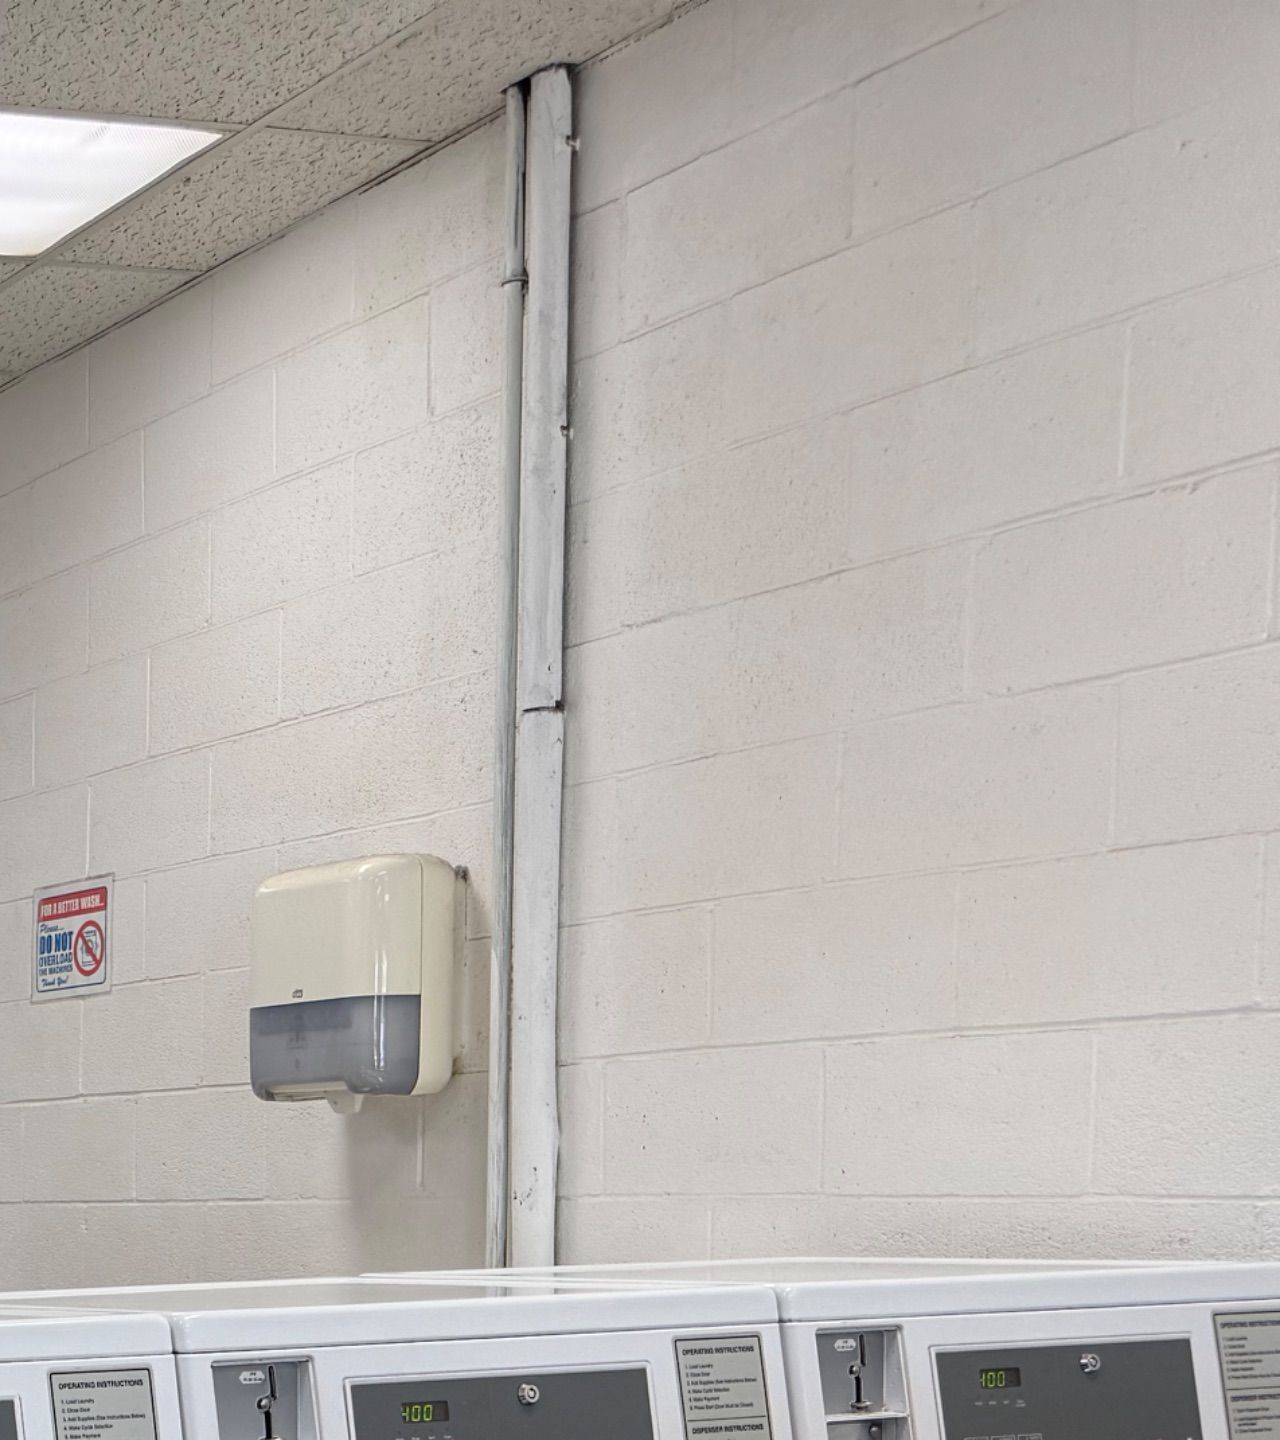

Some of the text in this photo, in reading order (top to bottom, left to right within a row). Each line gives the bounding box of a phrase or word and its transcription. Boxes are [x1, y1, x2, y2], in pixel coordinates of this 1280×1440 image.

[39, 931, 73, 954] DO NOT
[39, 952, 73, 967] OVERLOAD
[682, 1346, 754, 1356] OPERATING INSTRUCTIONS
[58, 1379, 143, 1390] OPERATING INSTRUCTIONS
[692, 1424, 764, 1434] DISPENSER INSTRUCTIONS
